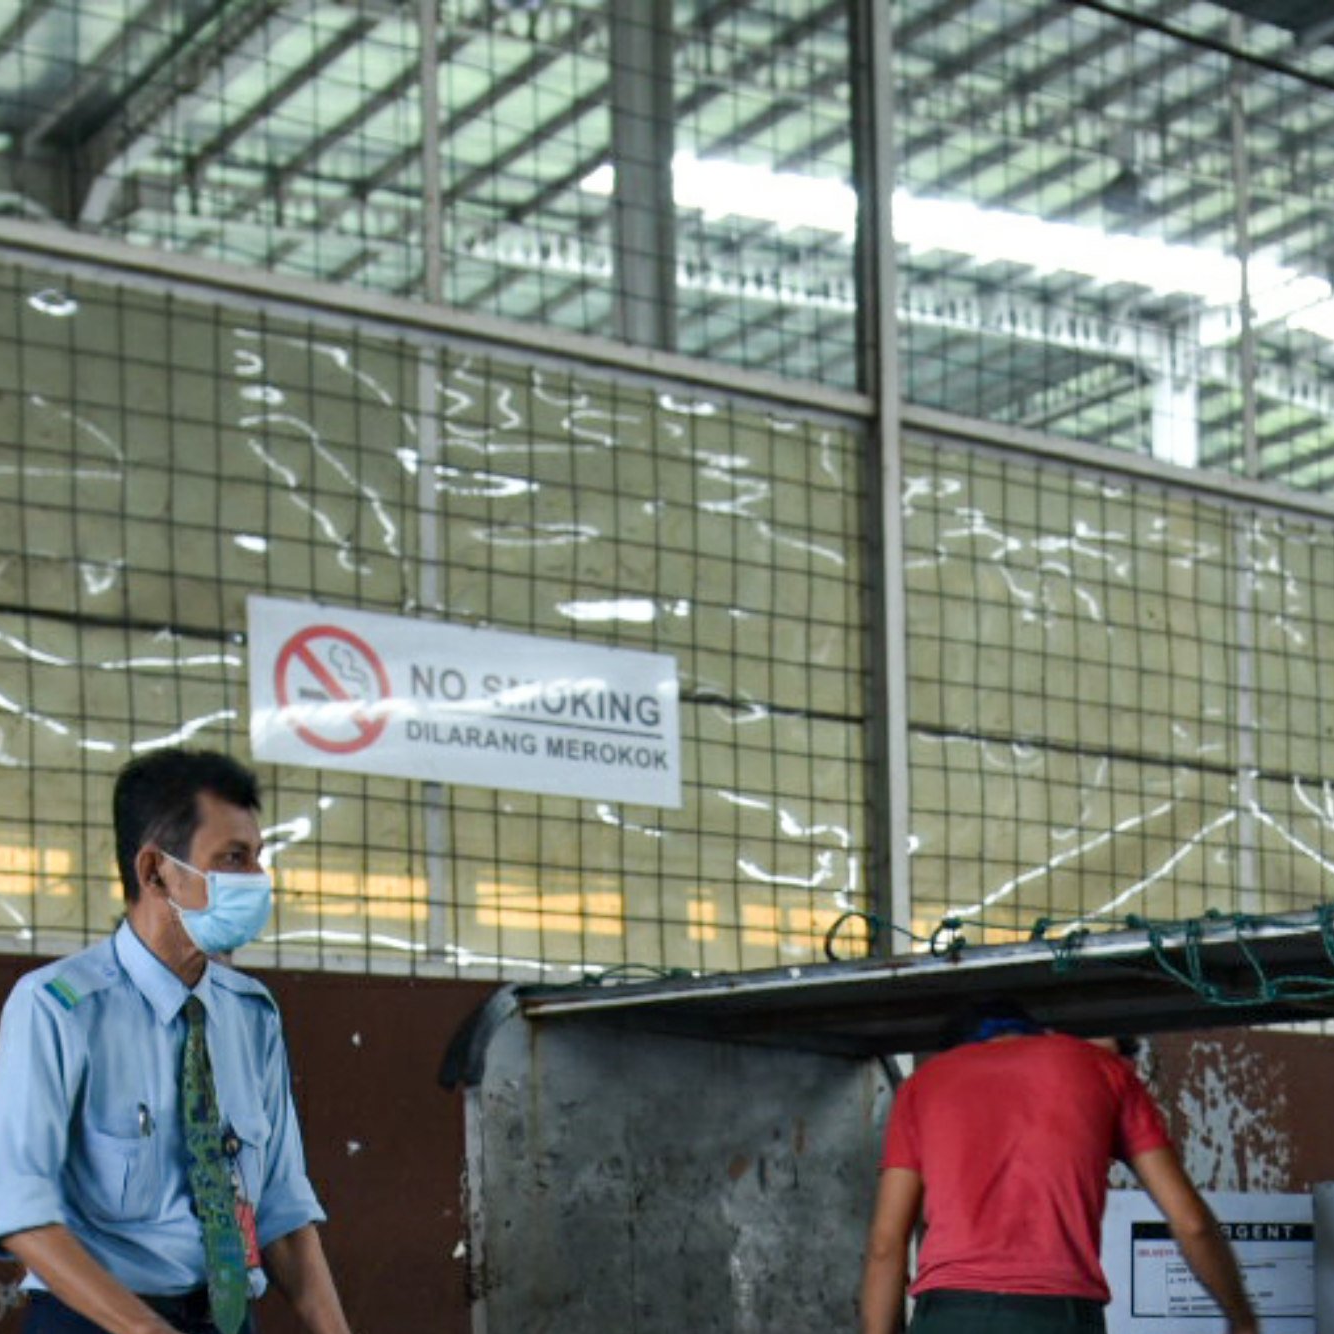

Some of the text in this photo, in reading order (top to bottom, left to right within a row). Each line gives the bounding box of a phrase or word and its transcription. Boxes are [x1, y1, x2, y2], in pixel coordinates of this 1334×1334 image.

[409, 663, 467, 702] NO
[405, 719, 669, 771] DILARANG MEROKOK
[1220, 1224, 1294, 1240] RGENT
